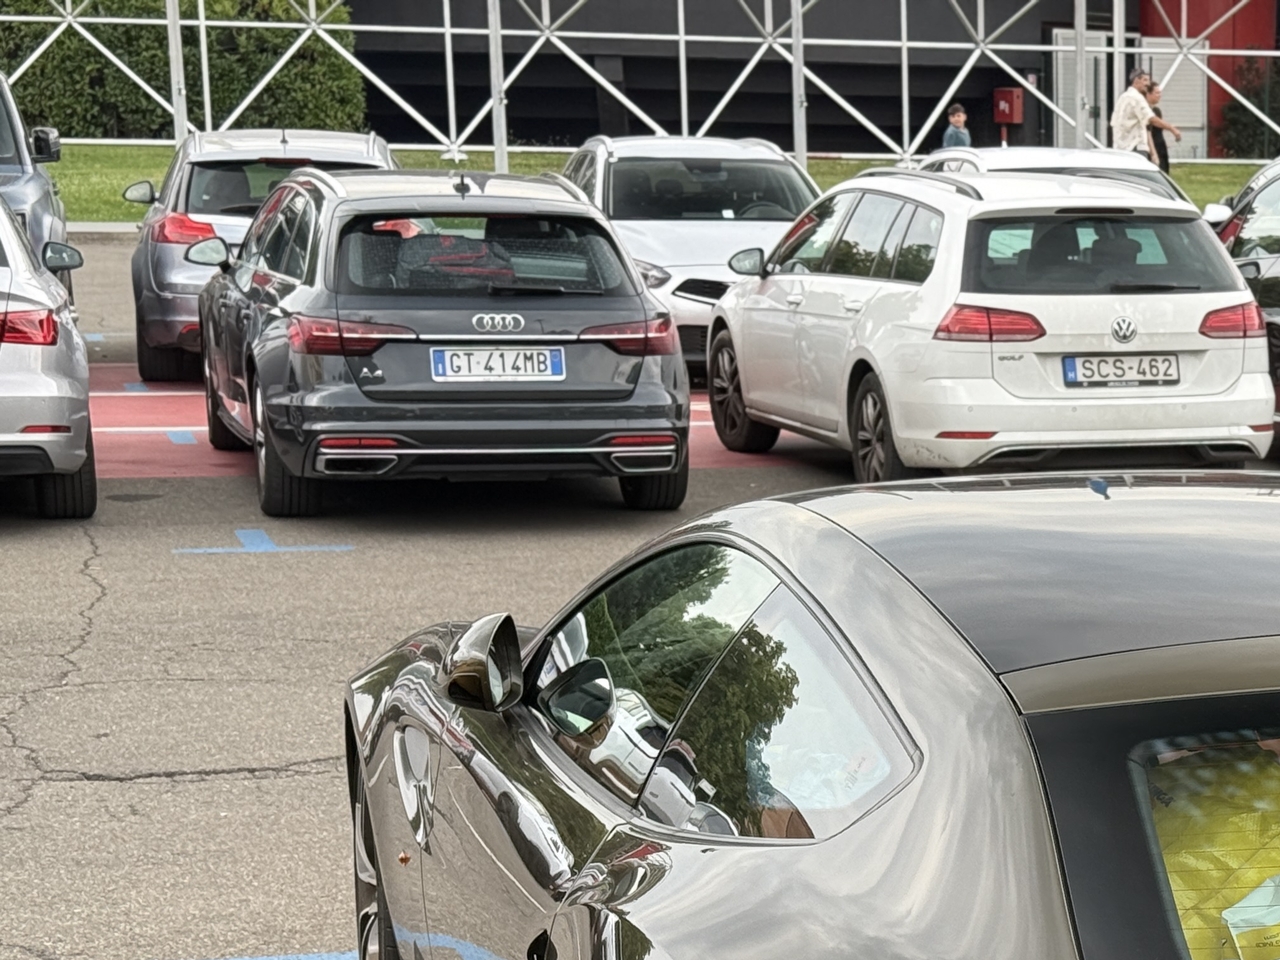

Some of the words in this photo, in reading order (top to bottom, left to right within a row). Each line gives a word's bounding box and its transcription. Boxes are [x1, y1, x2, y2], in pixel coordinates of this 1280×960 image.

[450, 352, 474, 374] GT
[483, 352, 548, 374] 414MB
[1082, 358, 1173, 378] SCS-462
